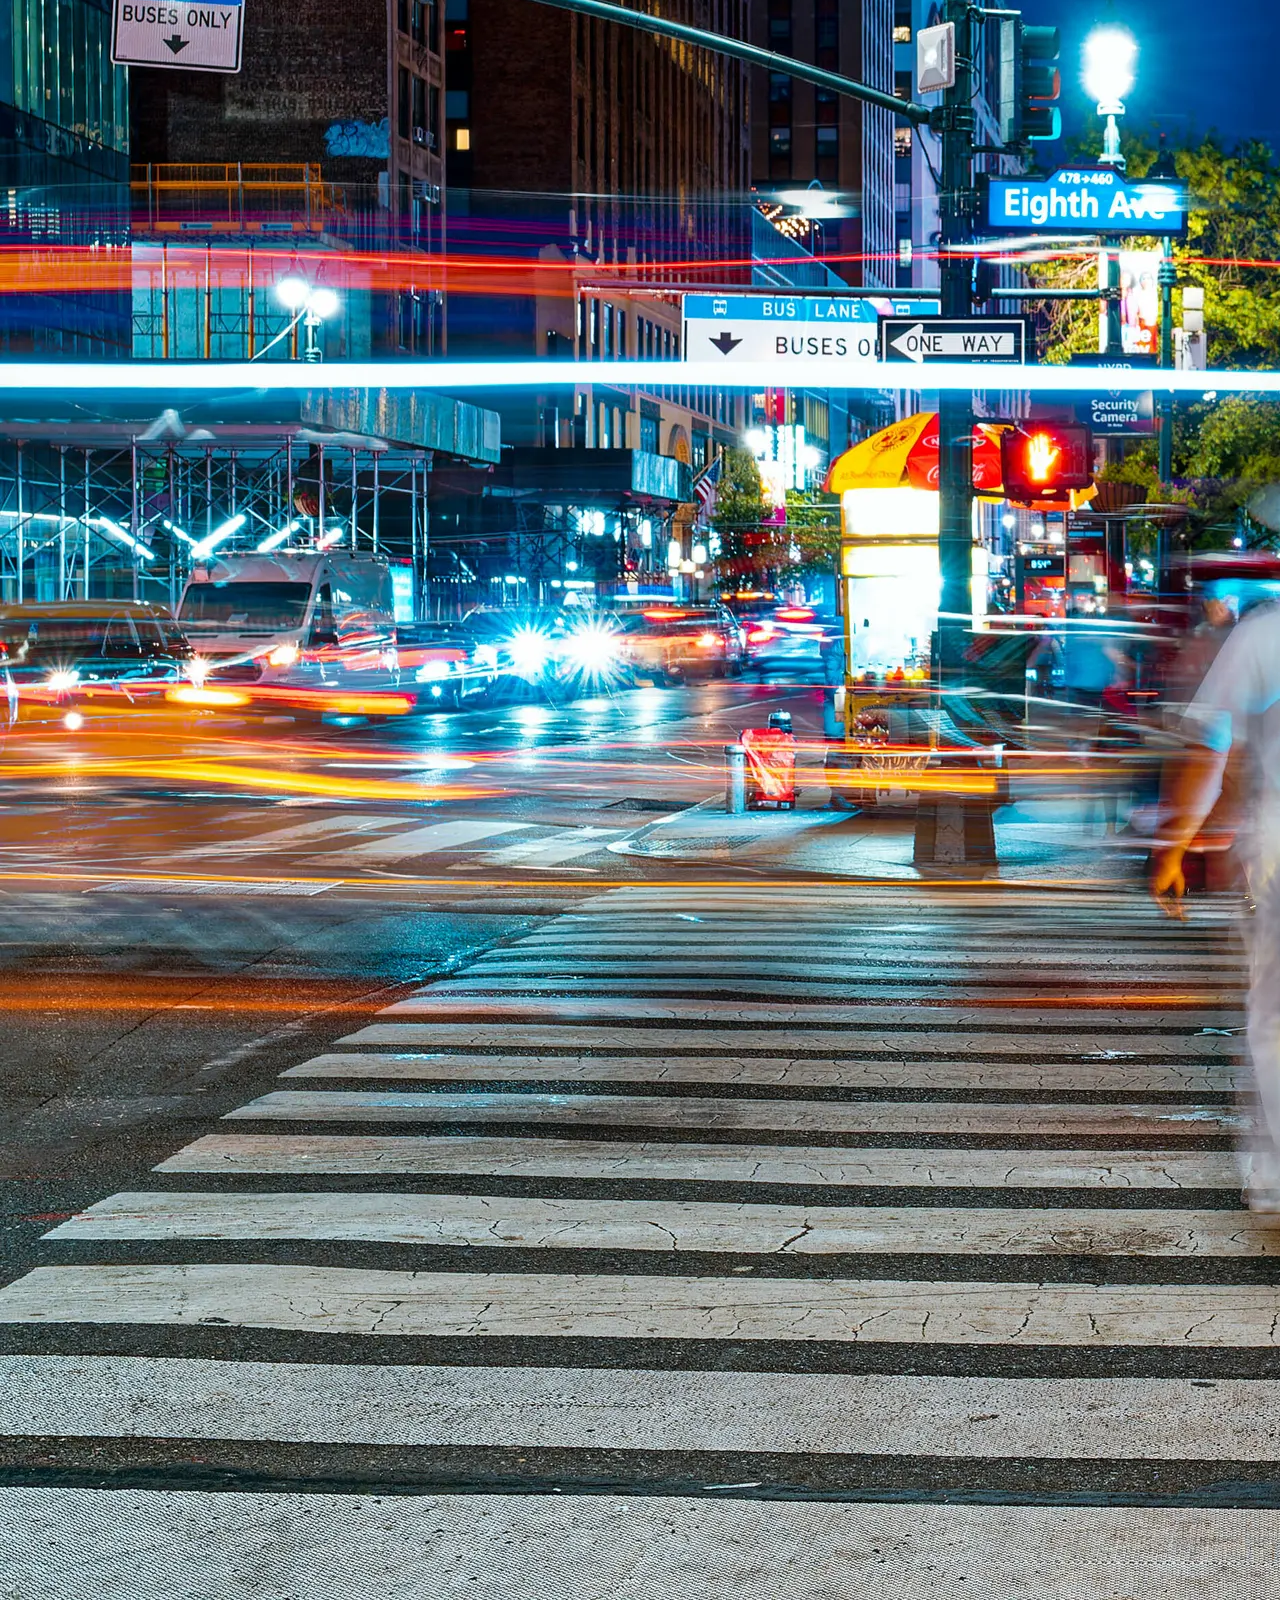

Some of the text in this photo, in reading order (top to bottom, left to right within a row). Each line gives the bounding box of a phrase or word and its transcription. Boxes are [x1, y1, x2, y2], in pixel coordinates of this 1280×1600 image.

[122, 4, 232, 29] BUSES ONLY
[1058, 172, 1114, 185] 478 460
[1004, 187, 1099, 224] Eighth
[762, 301, 861, 319] BUS LANE
[775, 336, 848, 356] BUSES
[906, 335, 1003, 353] ONE WAY
[1091, 398, 1139, 412] Security
[1092, 411, 1138, 422] Camera
